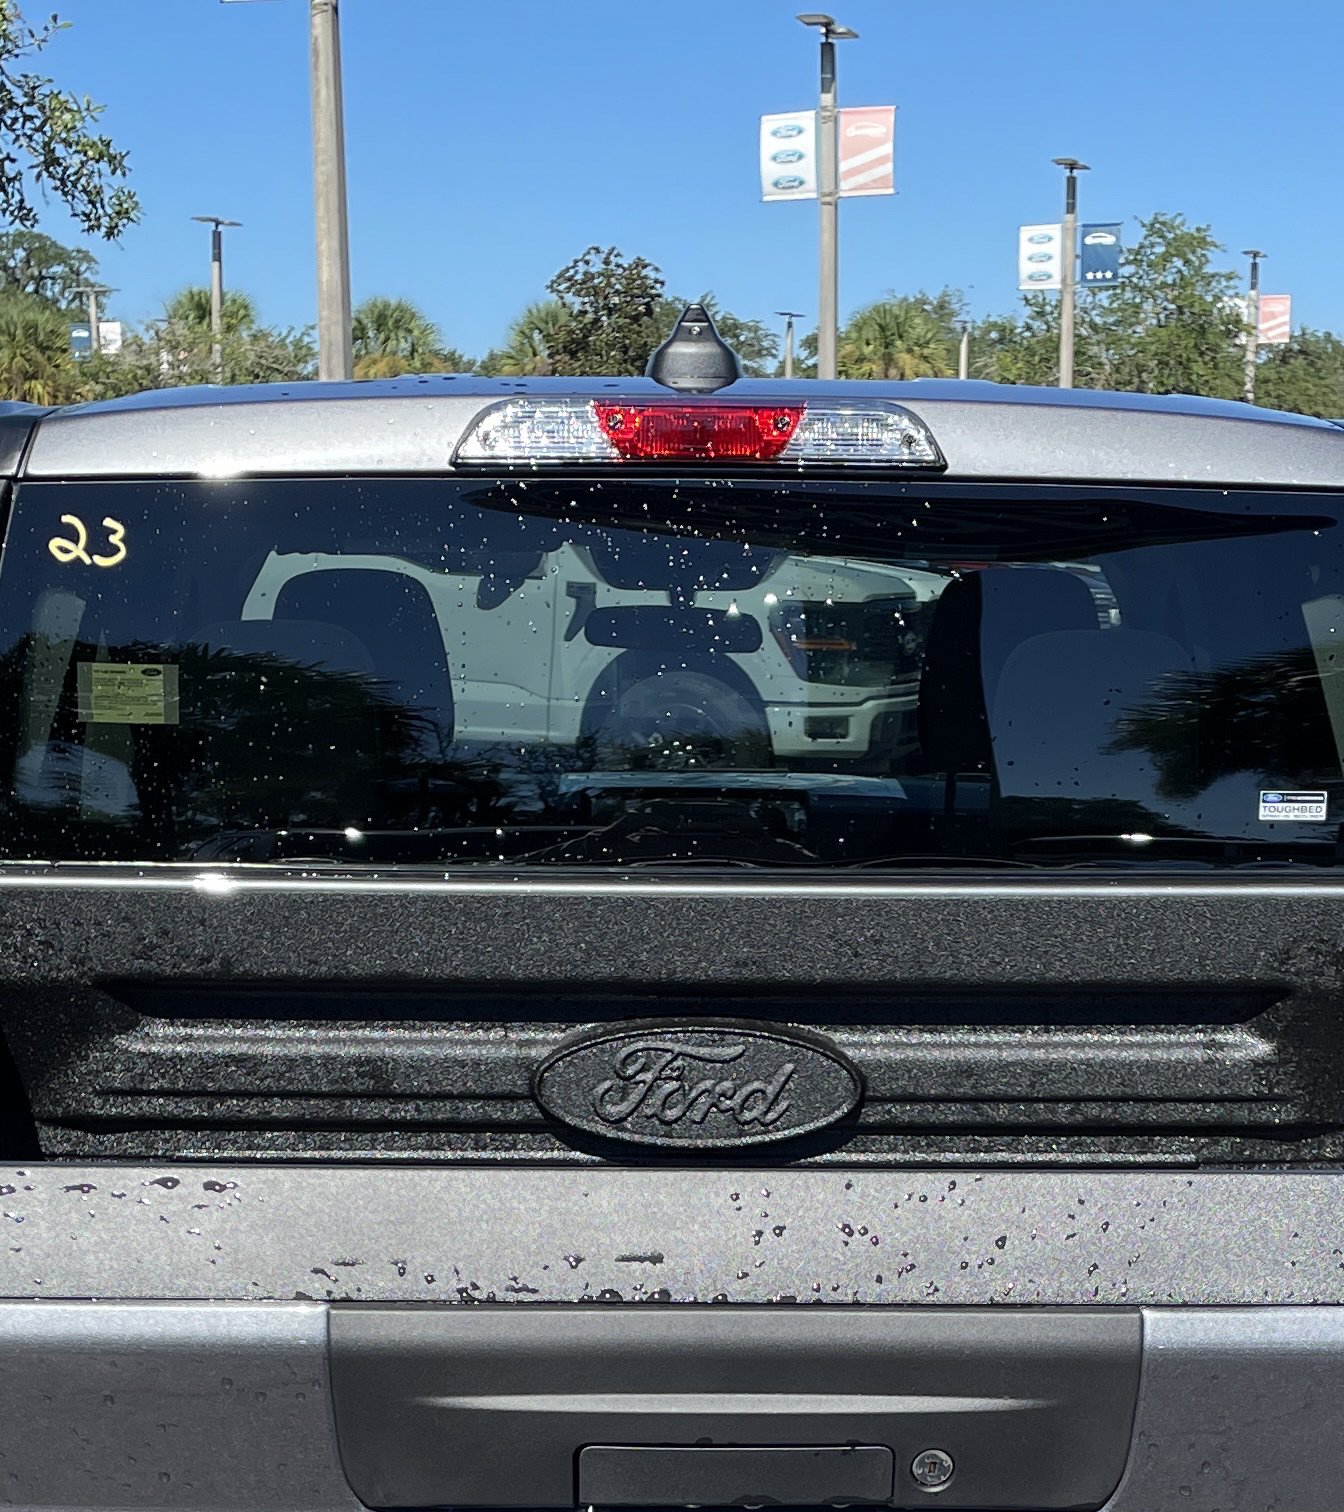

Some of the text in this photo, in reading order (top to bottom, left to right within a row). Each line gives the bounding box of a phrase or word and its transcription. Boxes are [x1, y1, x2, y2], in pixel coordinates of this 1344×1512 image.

[48, 514, 127, 567] 23
[1262, 805, 1323, 813] TOUGHBED
[593, 1041, 796, 1126] Ford
